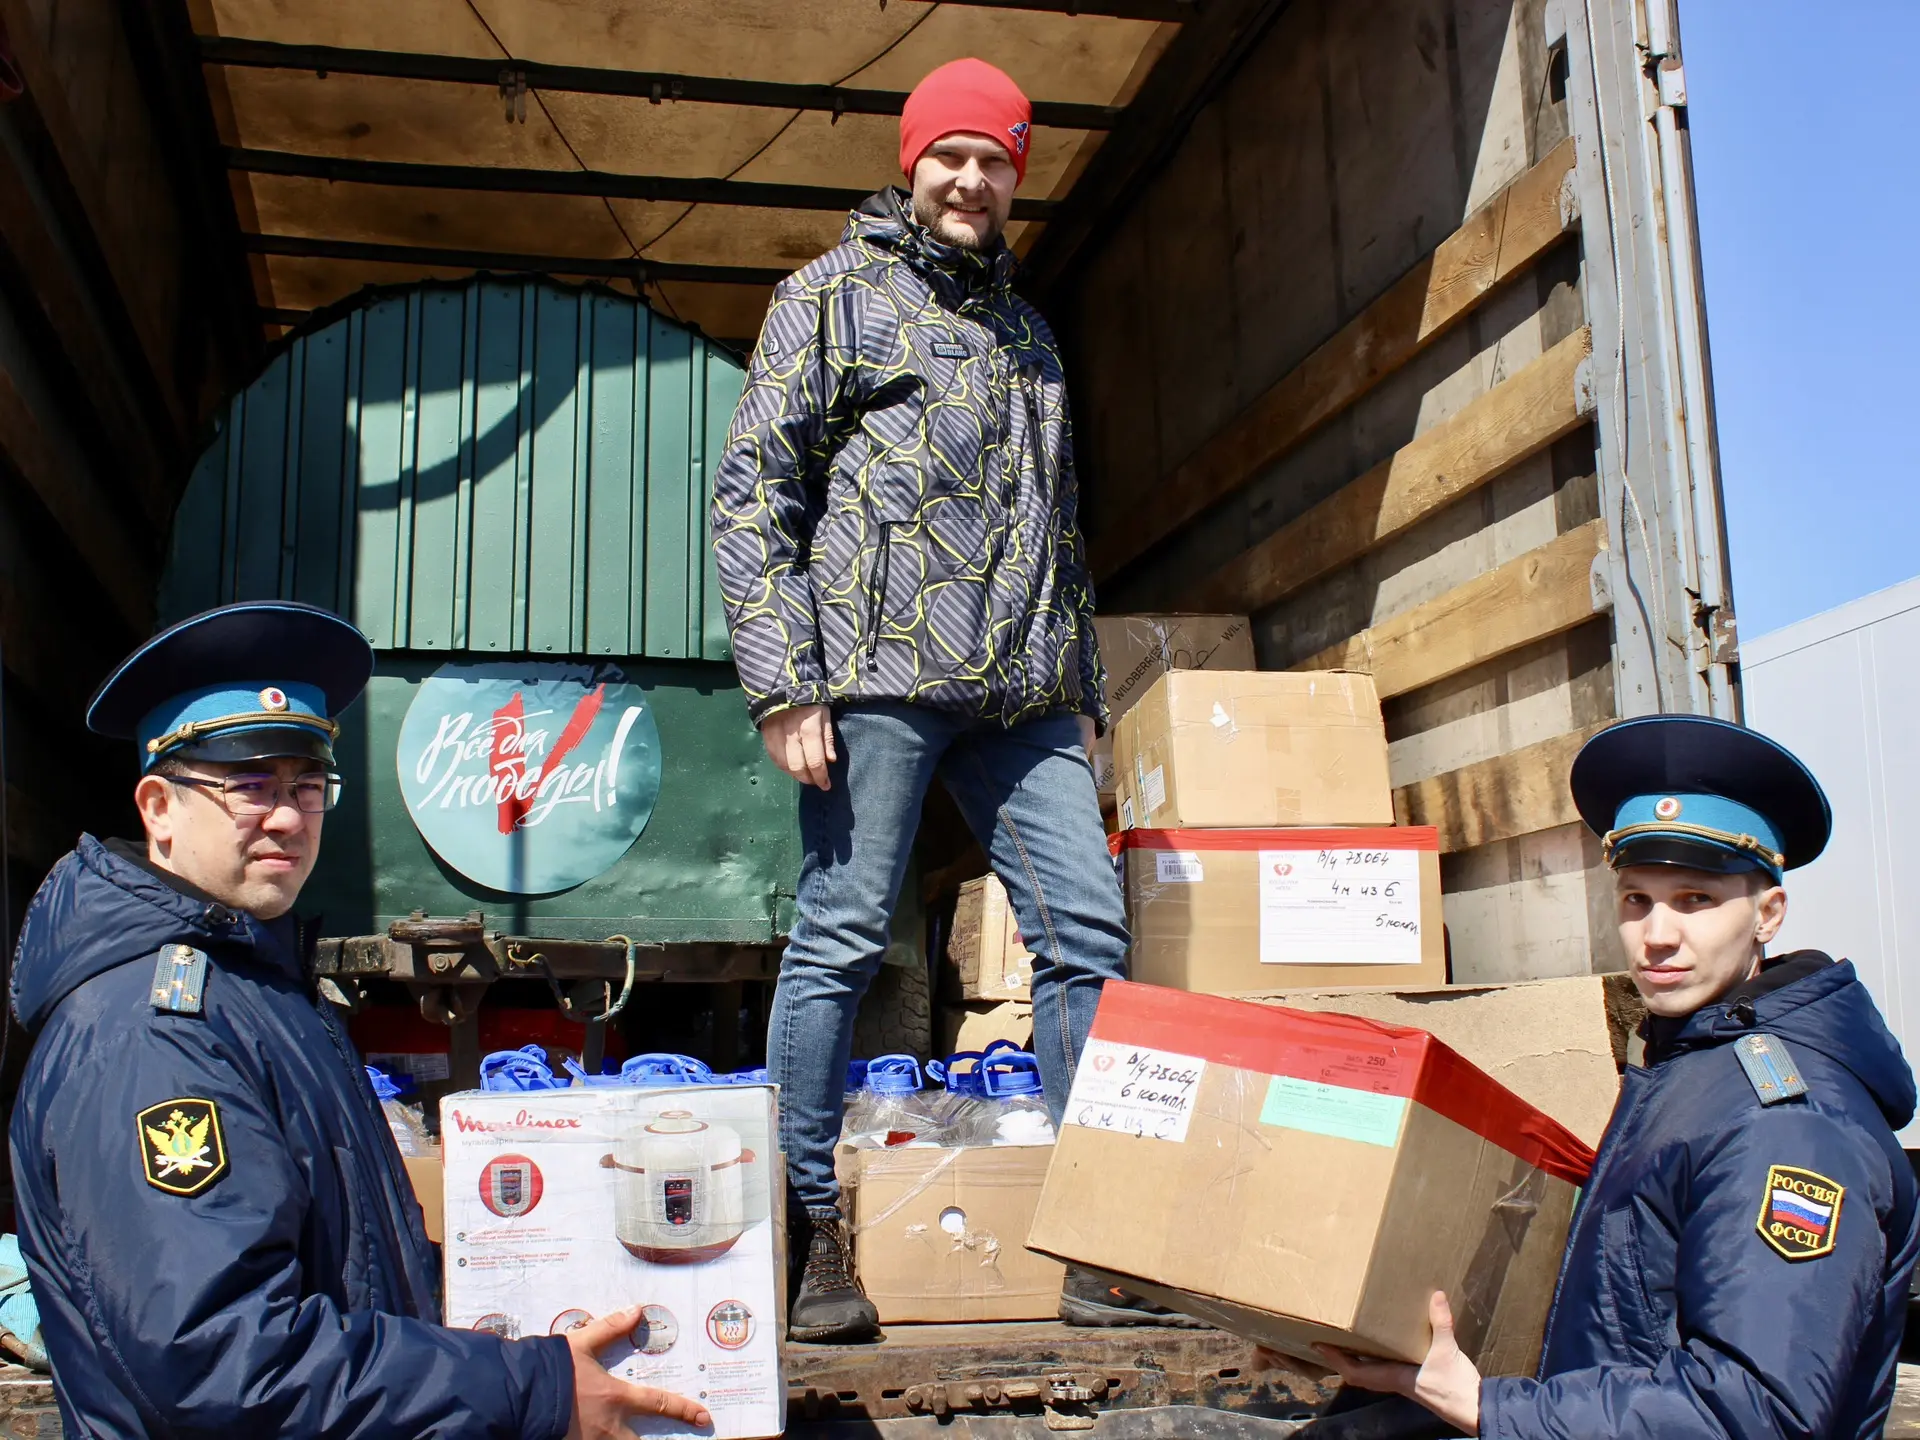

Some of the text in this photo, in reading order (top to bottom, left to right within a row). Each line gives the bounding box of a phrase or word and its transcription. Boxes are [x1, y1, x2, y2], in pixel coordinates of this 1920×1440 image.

[1112, 644, 1163, 702] WILDBERRIES
[1367, 1055, 1386, 1067] 250
[1771, 1173, 1838, 1205] РОССИЯ
[1770, 1221, 1820, 1249] ФССП
